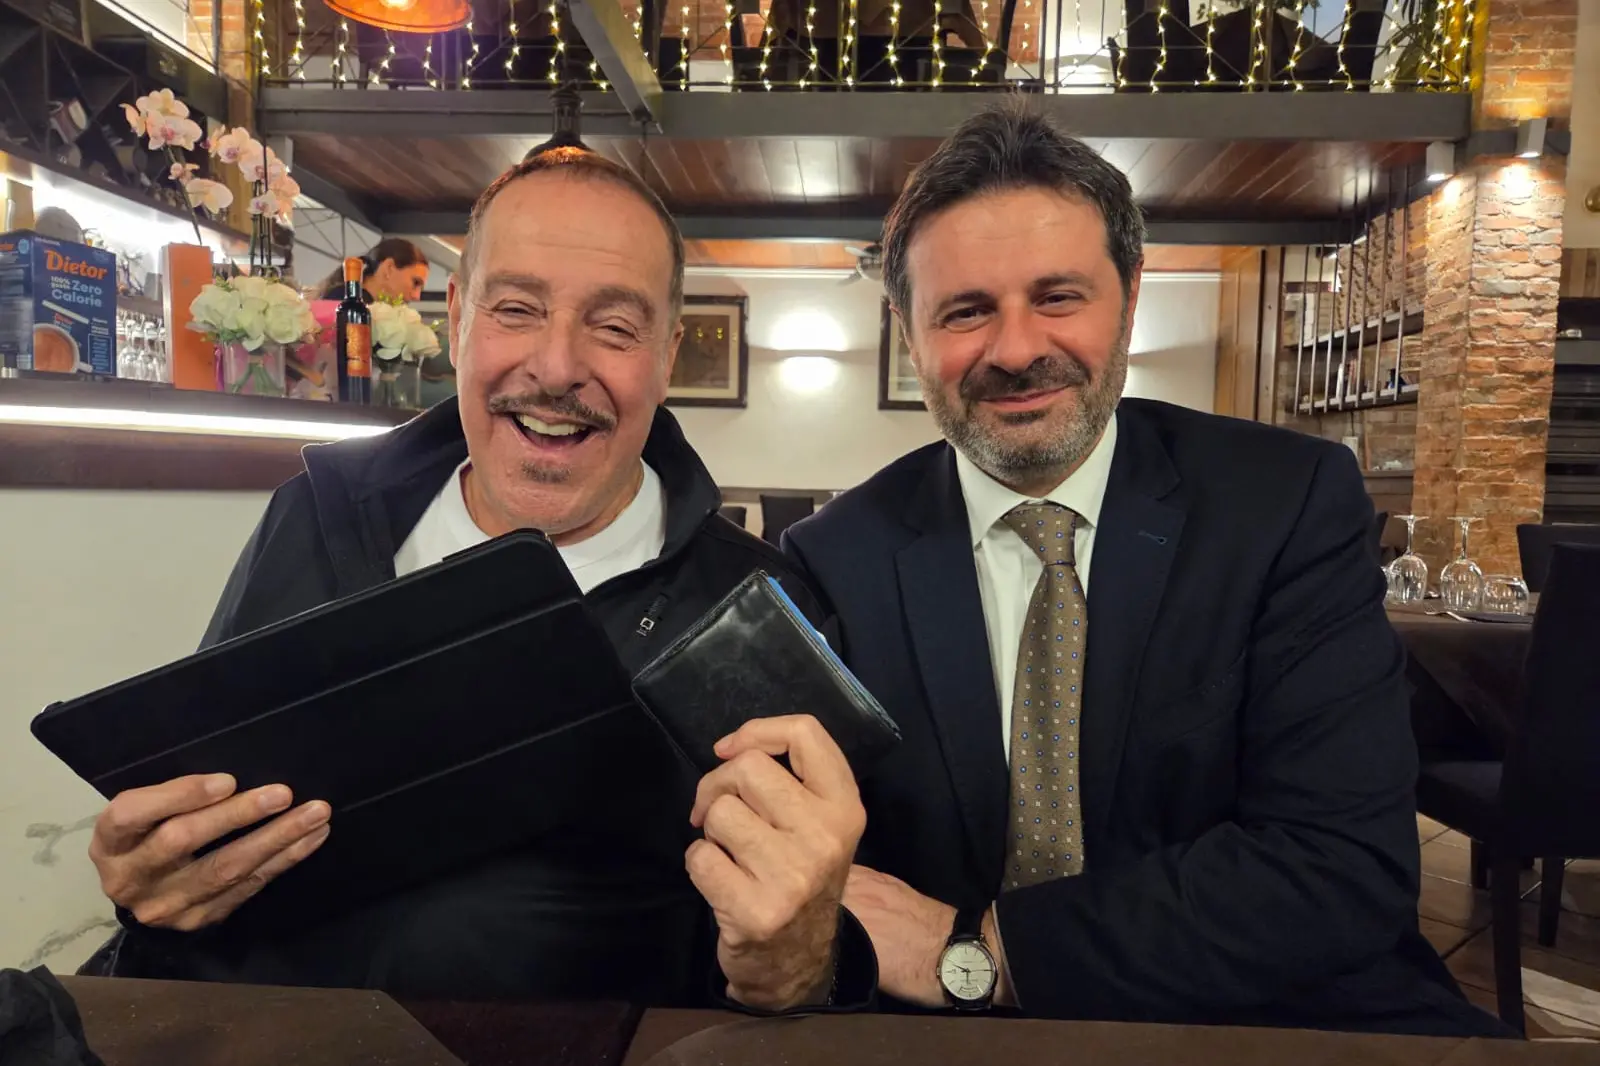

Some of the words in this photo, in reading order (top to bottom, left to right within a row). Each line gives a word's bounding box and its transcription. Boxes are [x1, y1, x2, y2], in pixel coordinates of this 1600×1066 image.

[44, 249, 108, 280] Dietor
[51, 276, 70, 285] 100%
[71, 280, 102, 295] Zero
[51, 289, 102, 307] Calorie
